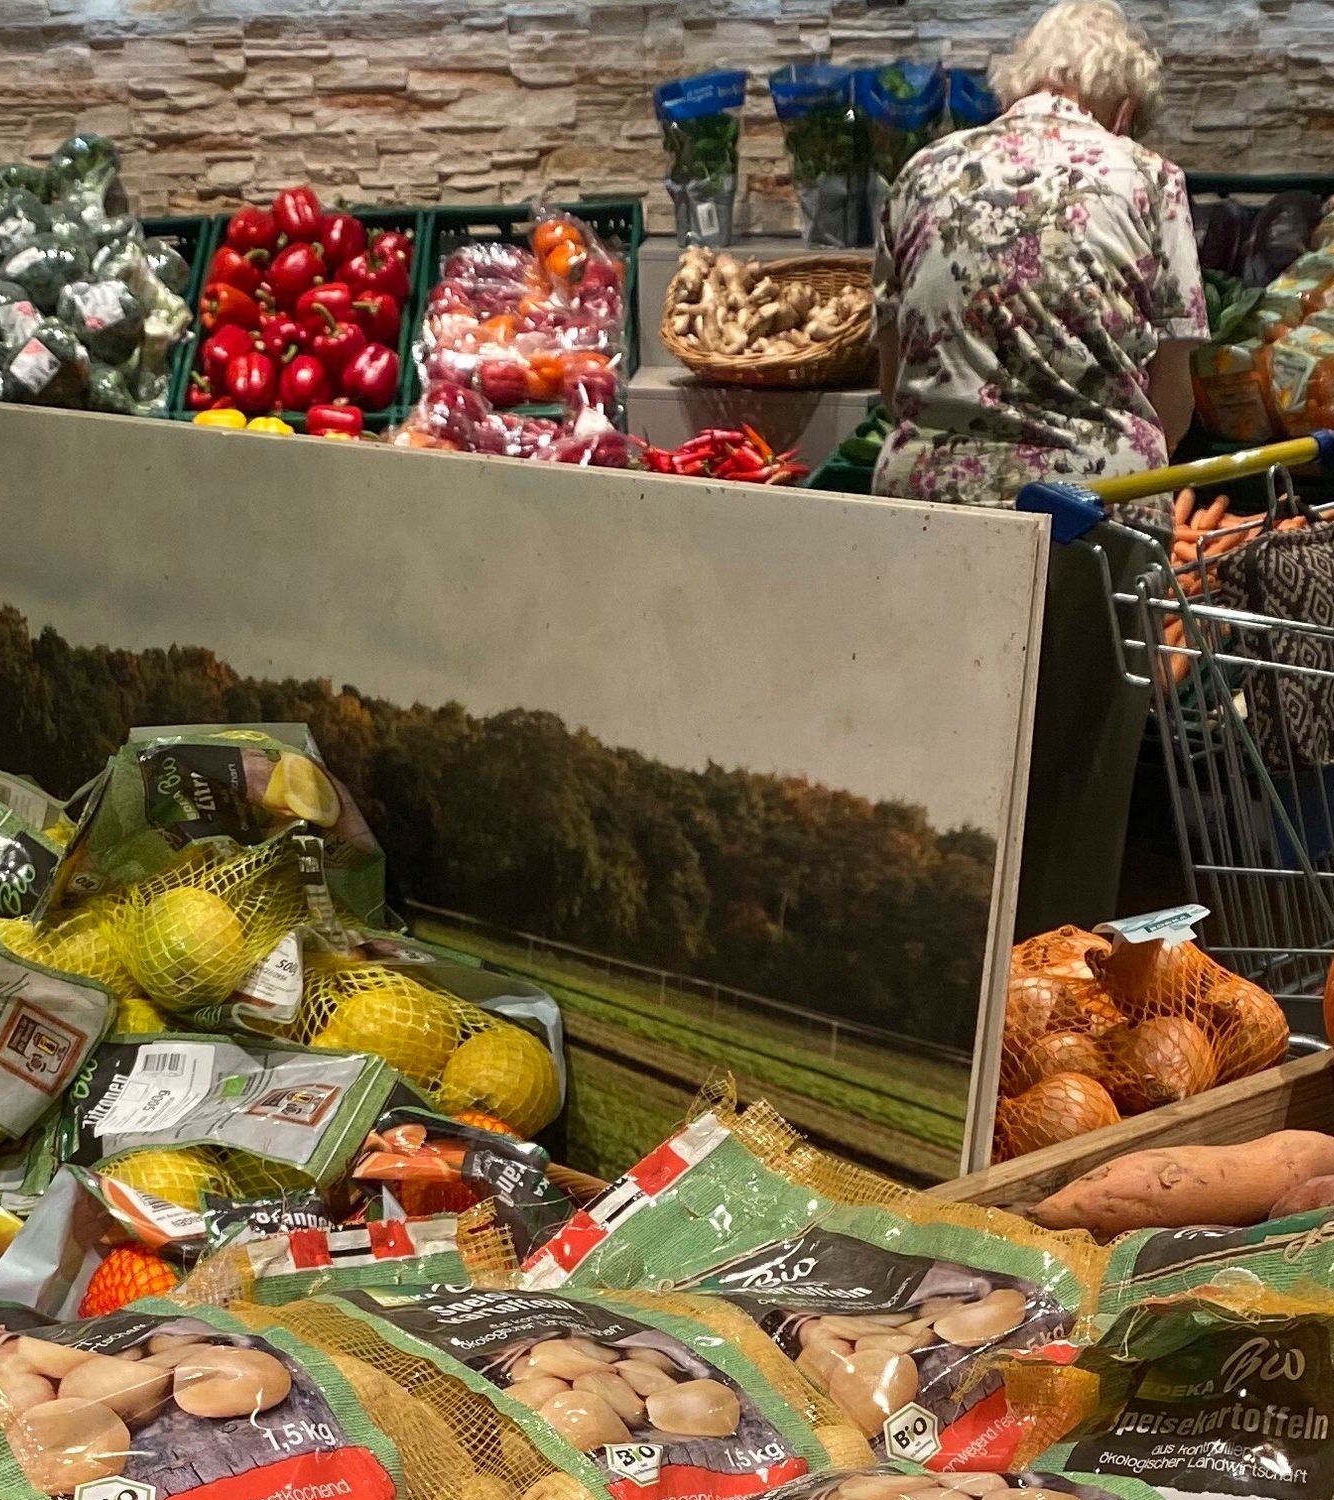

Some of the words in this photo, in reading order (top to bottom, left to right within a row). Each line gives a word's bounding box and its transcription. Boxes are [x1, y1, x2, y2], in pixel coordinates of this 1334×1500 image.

[1220, 1337, 1306, 1393] Bio
[305, 1419, 336, 1450] kg
[1099, 1451, 1185, 1473] ökologischer
[1151, 1443, 1175, 1456] aus
